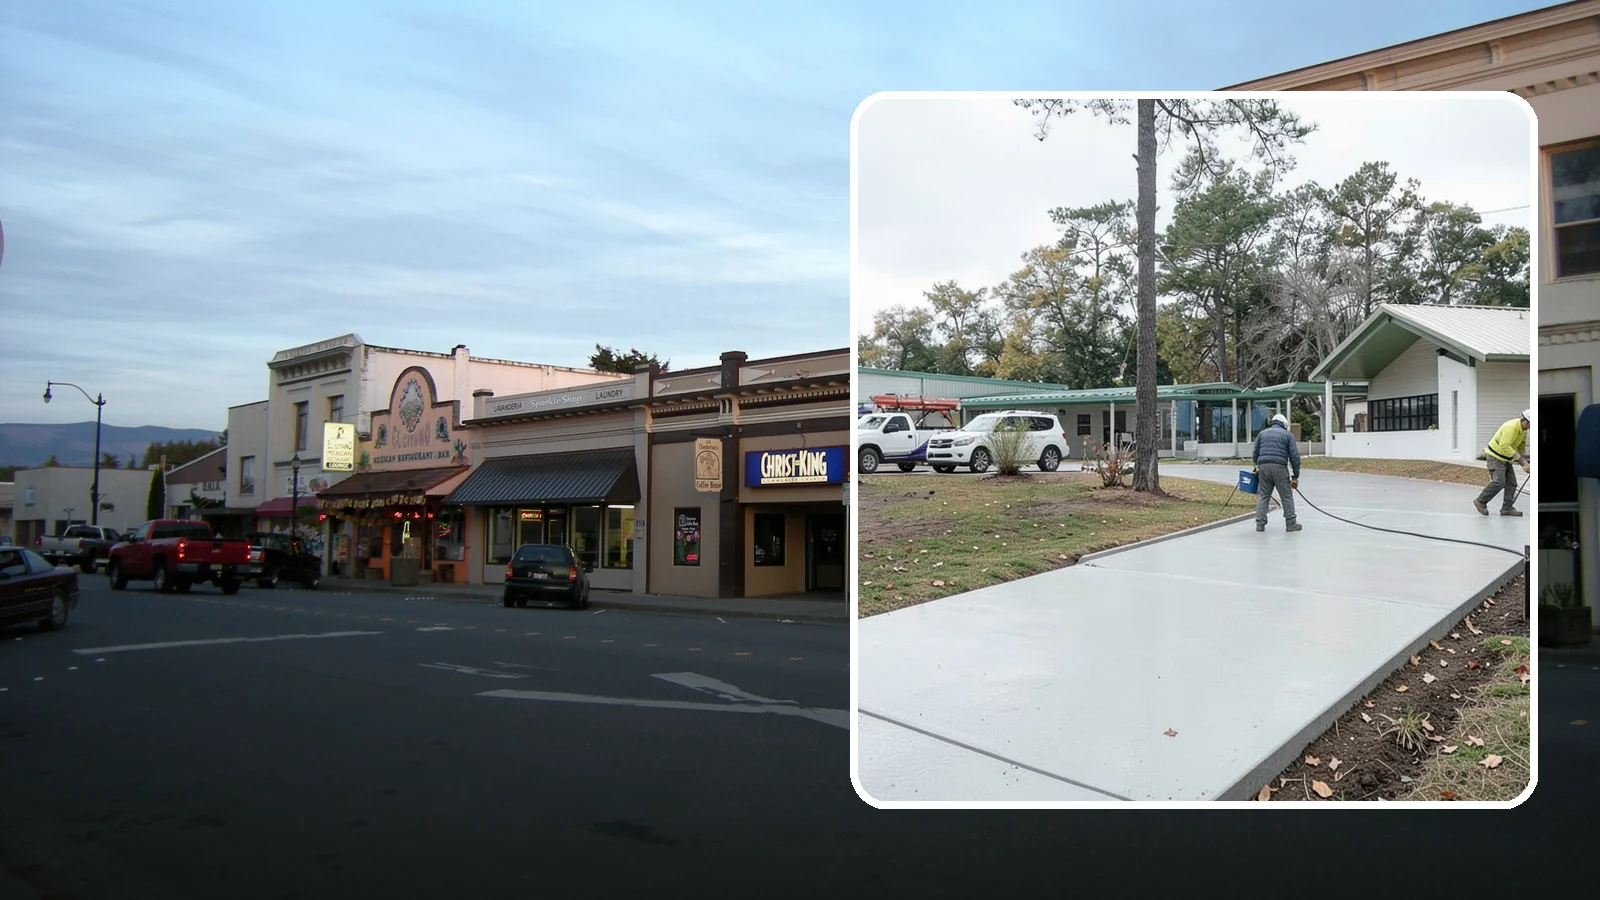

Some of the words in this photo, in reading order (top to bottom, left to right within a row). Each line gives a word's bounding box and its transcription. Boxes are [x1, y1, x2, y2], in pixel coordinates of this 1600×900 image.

[562, 394, 582, 406] Shop
[595, 389, 623, 400] LAUNDRY
[493, 402, 522, 412] LAVANDERIA
[373, 454, 396, 464] MEXICAN
[398, 451, 433, 462] RESTAURANT
[438, 450, 450, 459] BAR
[761, 452, 797, 478] CHRIST
[799, 450, 827, 476] KING
